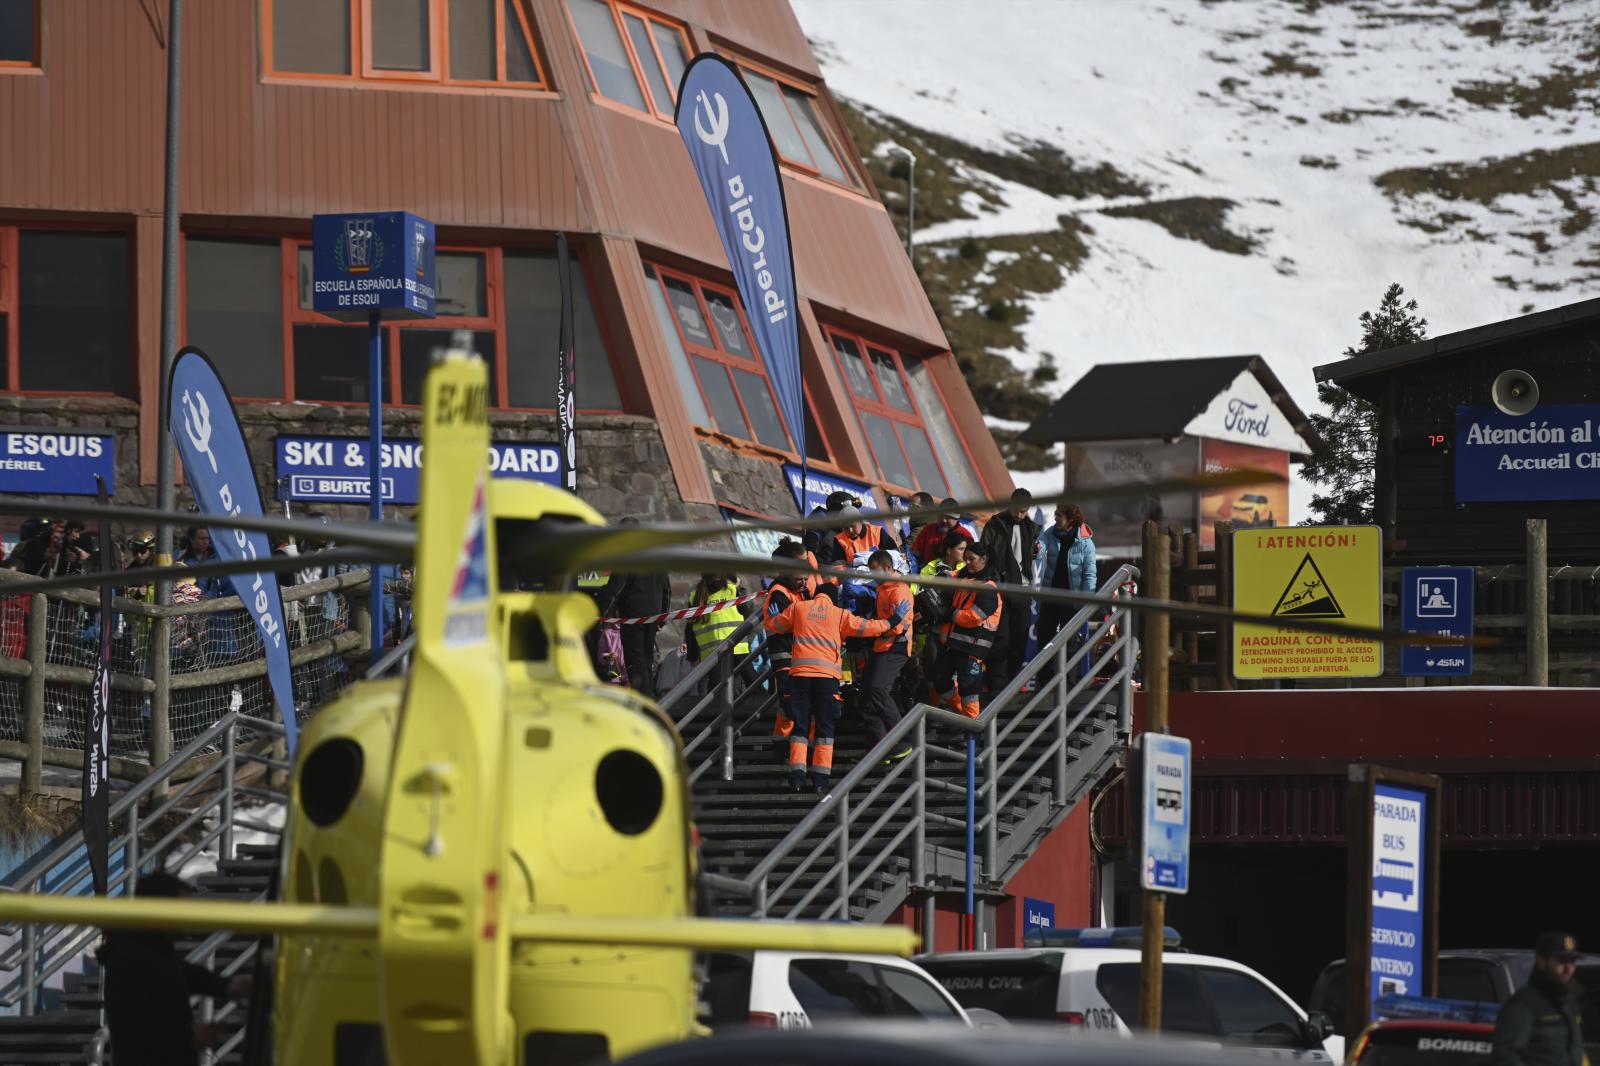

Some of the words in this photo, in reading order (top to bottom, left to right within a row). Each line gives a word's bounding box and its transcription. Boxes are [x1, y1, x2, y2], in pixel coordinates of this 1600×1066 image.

[315, 279, 355, 292] ESCUELA
[357, 276, 402, 291] ESPAÑOLA
[338, 295, 351, 305] DE
[352, 294, 380, 305] ESQUI
[1225, 398, 1269, 438] Ford
[1466, 421, 1565, 445] Atención
[1571, 419, 1593, 443] al
[7, 433, 103, 458] ESQUIS
[284, 441, 334, 466] SKI
[344, 442, 364, 467] &
[1498, 453, 1571, 471] Accueil
[1240, 636, 1300, 646] MAQUINA
[1305, 635, 1333, 645] CON
[1241, 648, 1294, 656] ESTRICTAMENTE
[1296, 647, 1334, 655] PROHIBIDO
[1346, 646, 1373, 654] ACCESO
[1239, 657, 1248, 665] AL
[1250, 657, 1283, 665] DOMINIO
[1286, 656, 1324, 664] ESQUIABLE
[1325, 656, 1348, 664] FUERA
[1262, 666, 1300, 674] HORARIOS
[1374, 800, 1417, 823] PARADA
[1383, 833, 1405, 851] BUS
[1371, 926, 1416, 949] SERVICIO
[1371, 955, 1414, 977] INTERNO
[988, 976, 1022, 990] CIVIL
